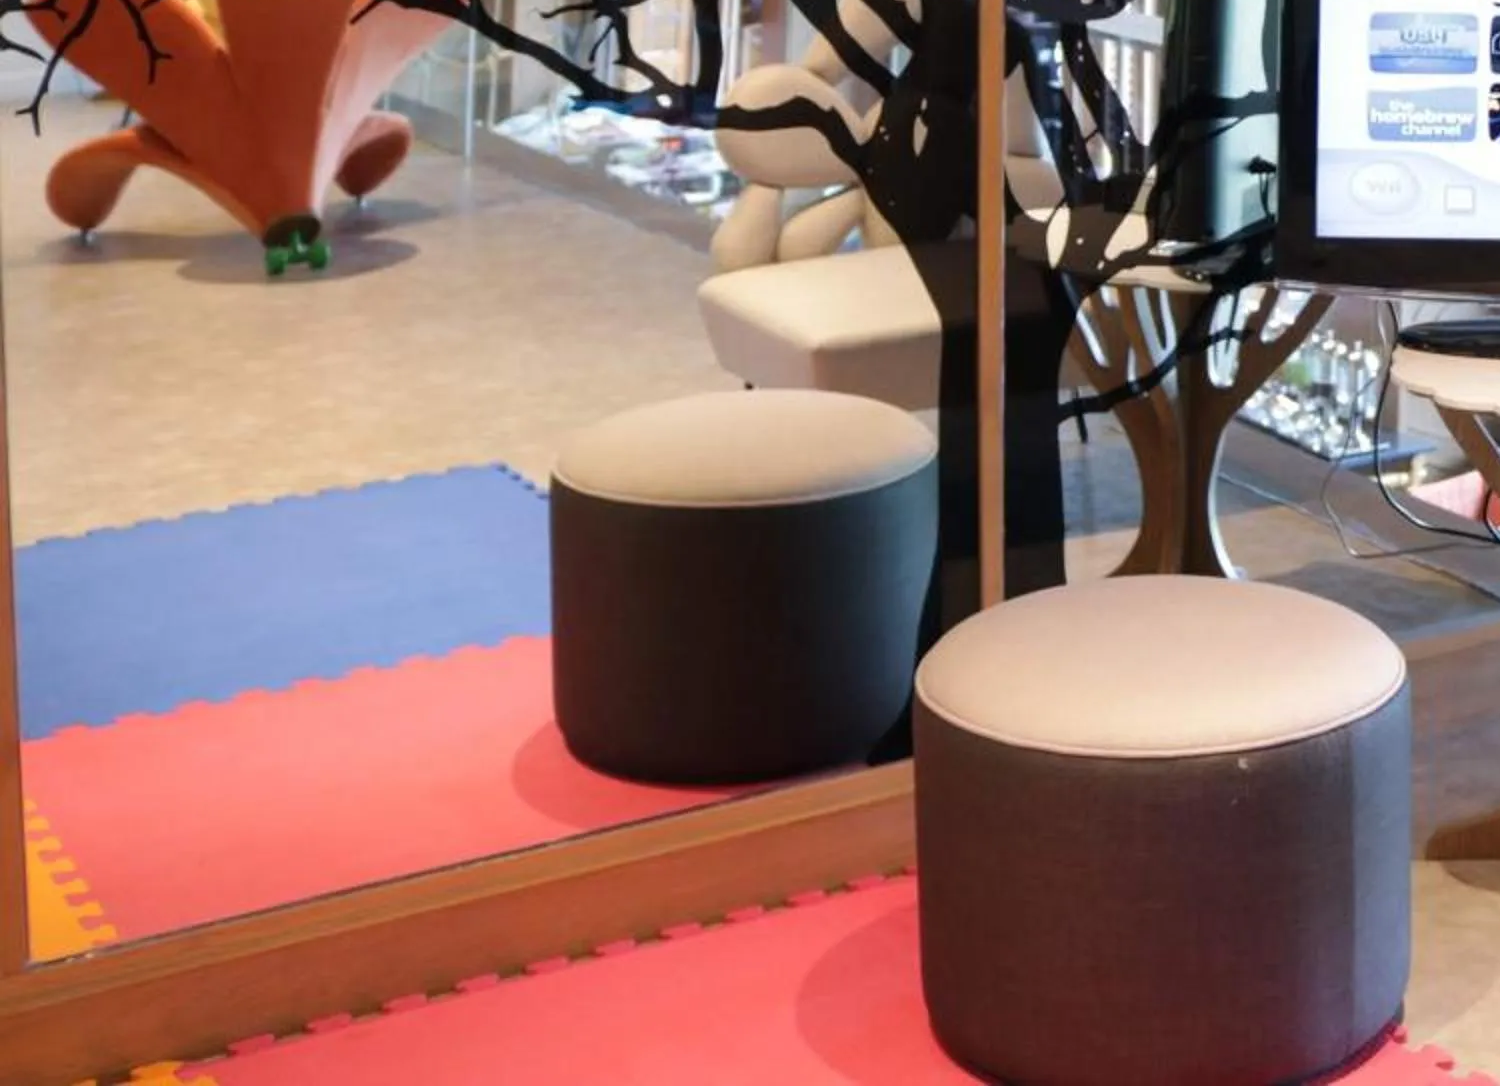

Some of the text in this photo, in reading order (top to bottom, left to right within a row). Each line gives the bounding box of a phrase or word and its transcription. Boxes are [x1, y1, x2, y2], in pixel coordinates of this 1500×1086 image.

[1388, 98, 1415, 112] the
[1370, 107, 1475, 125] homebrew
[1401, 122, 1461, 136] channel
